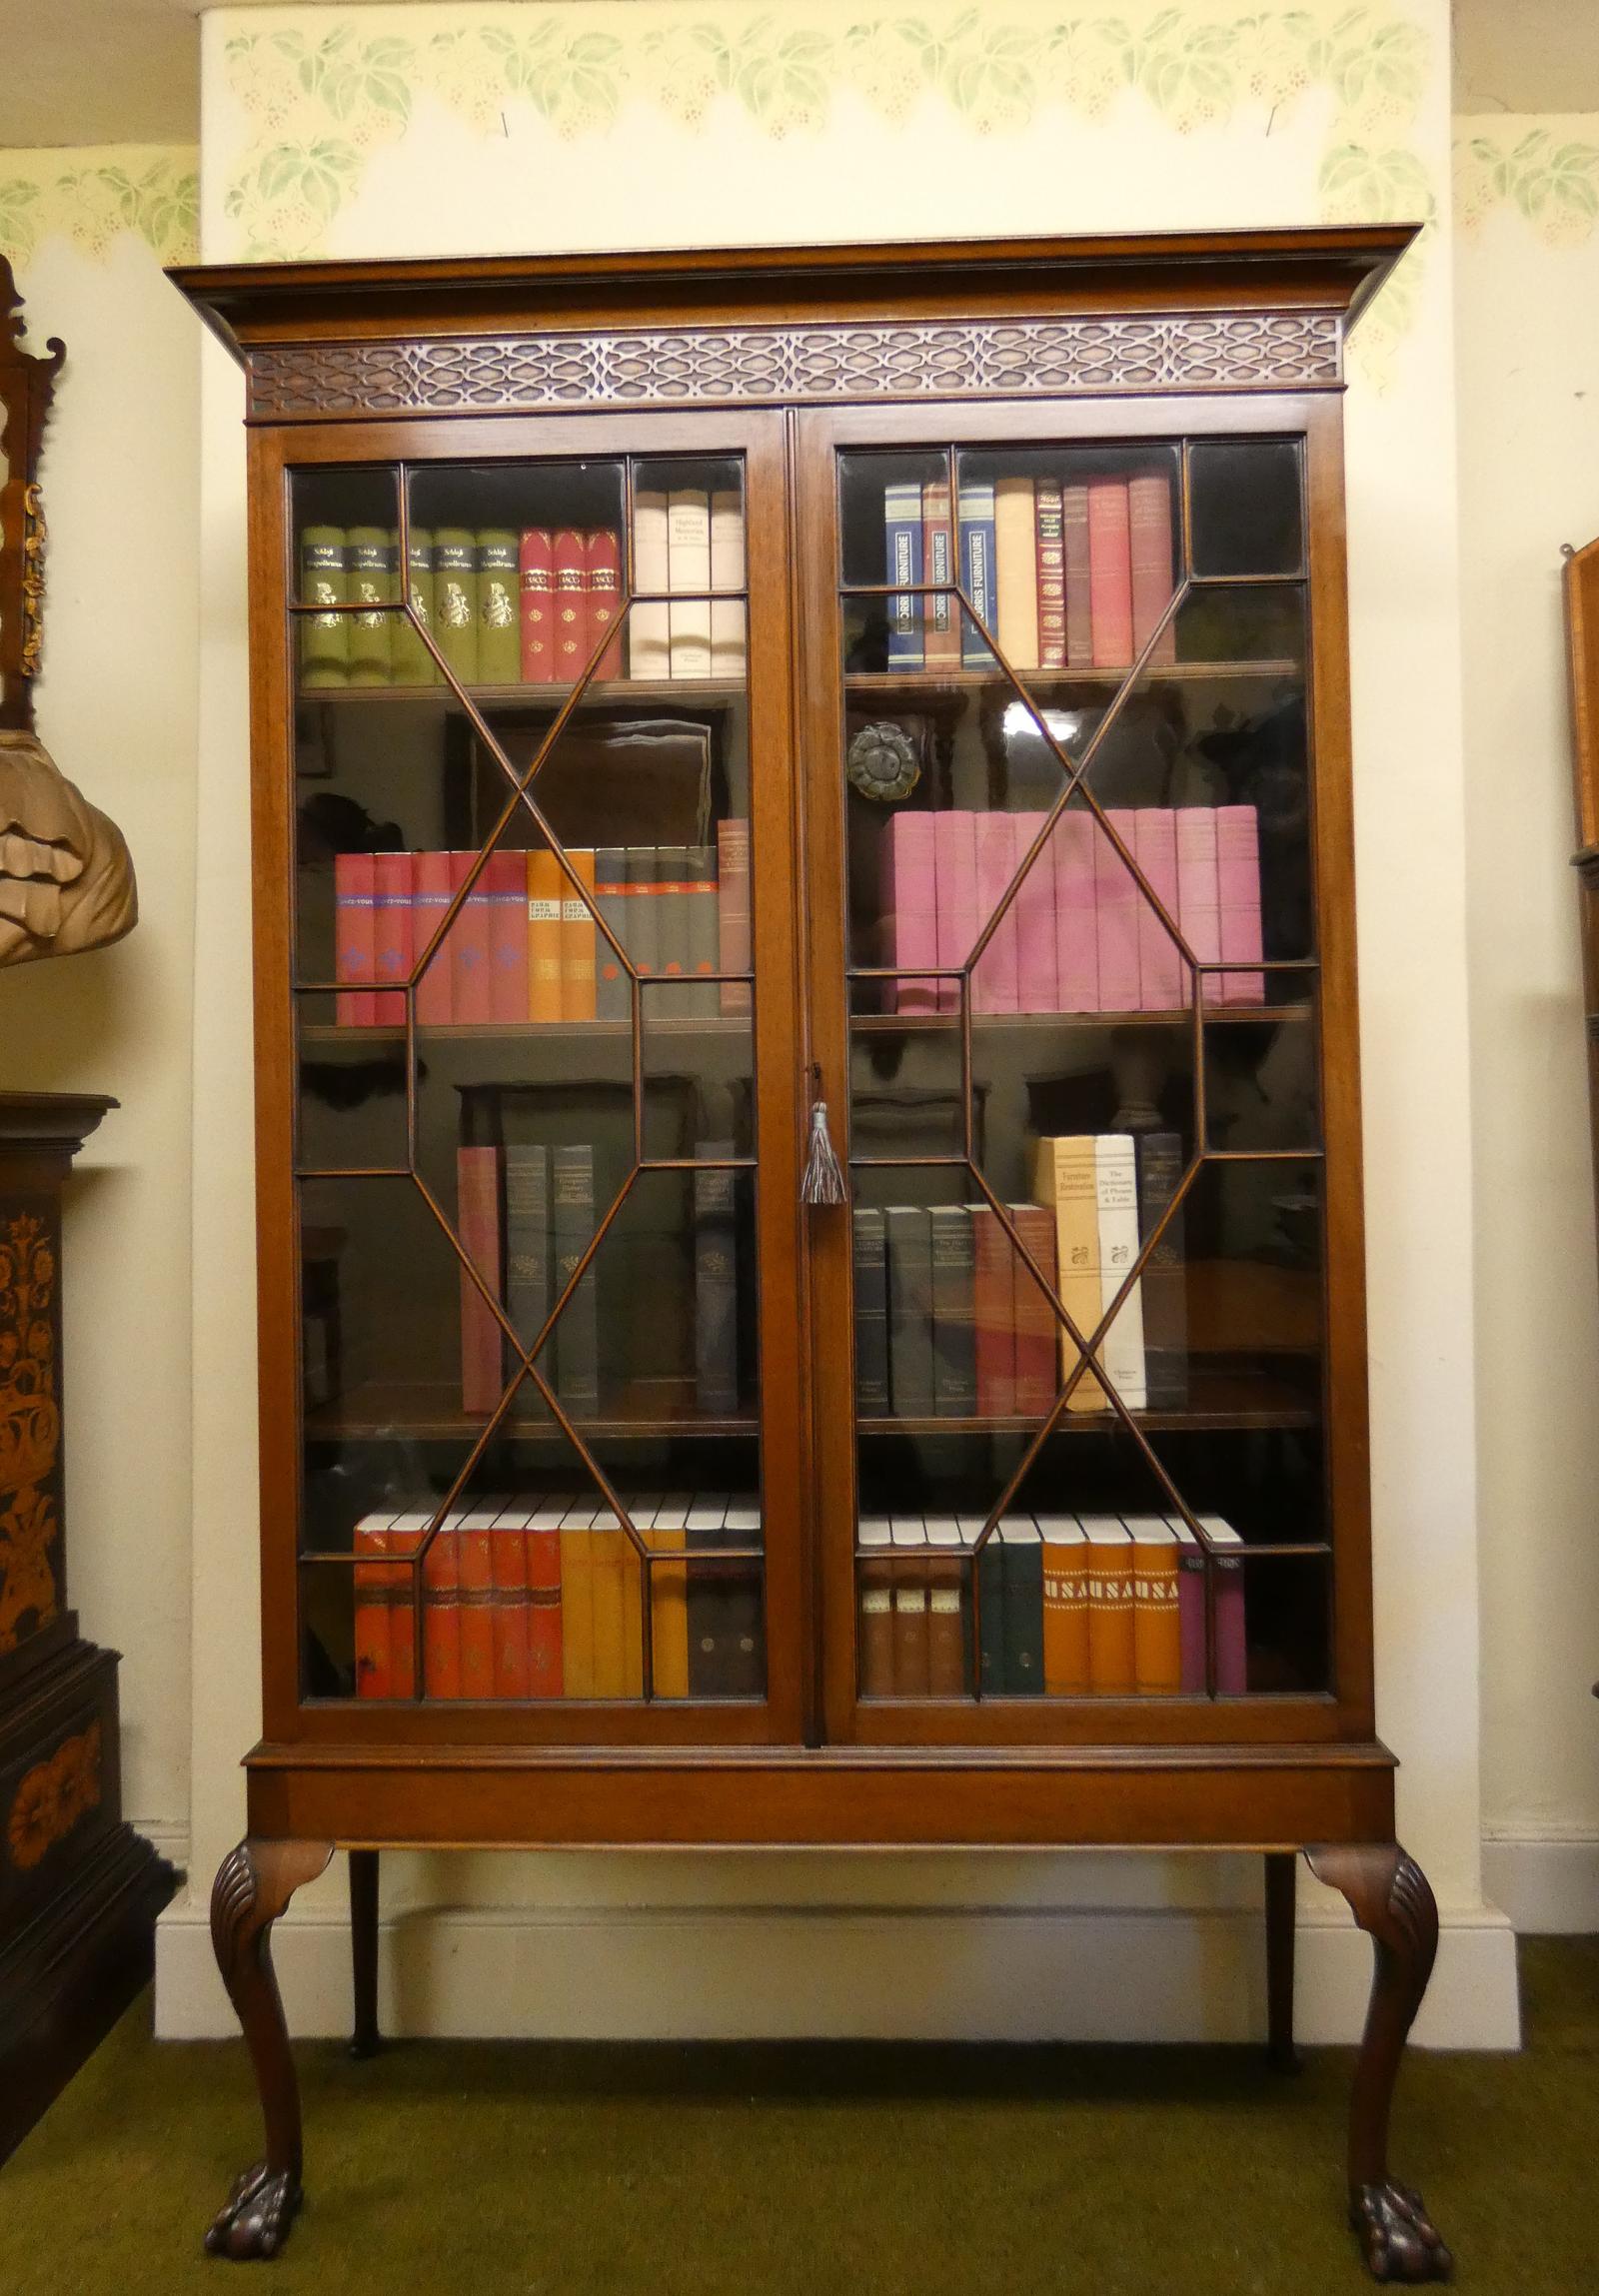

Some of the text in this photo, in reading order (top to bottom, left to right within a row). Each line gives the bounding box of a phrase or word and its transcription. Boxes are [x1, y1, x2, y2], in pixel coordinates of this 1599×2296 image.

[972, 535, 984, 619] ORRIS FURNITURE
[899, 595, 909, 631] MORRI
[935, 595, 946, 631] MORRI
[1044, 1580, 1179, 1599] USA USA USA
